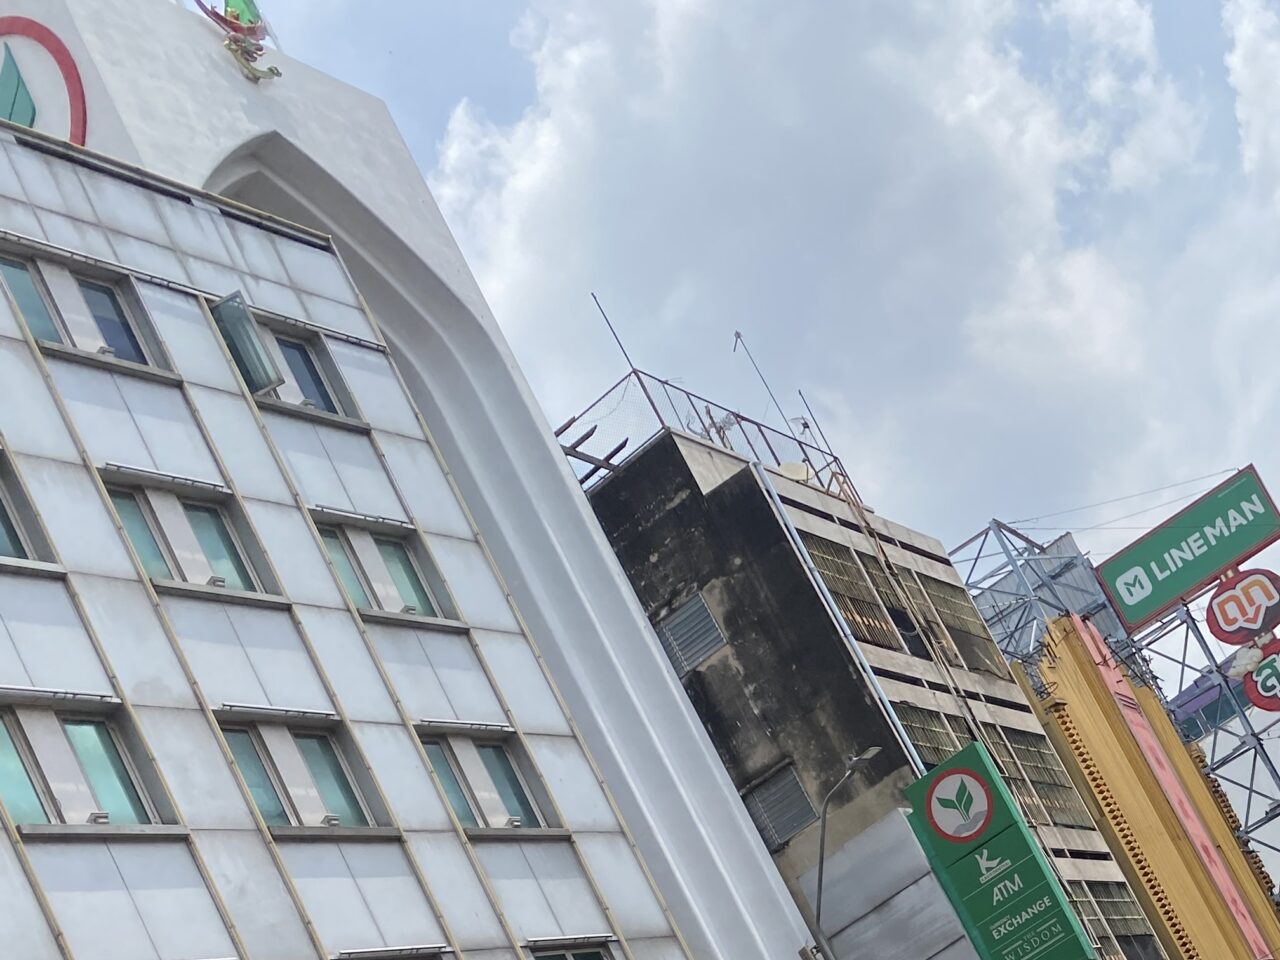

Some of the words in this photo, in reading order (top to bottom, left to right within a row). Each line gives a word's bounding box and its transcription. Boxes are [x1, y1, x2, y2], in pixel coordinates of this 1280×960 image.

[1150, 532, 1208, 582] LINE
[1202, 493, 1266, 546] MAN
[992, 873, 1024, 906] ATM
[992, 896, 1053, 941] EXCHANGE
